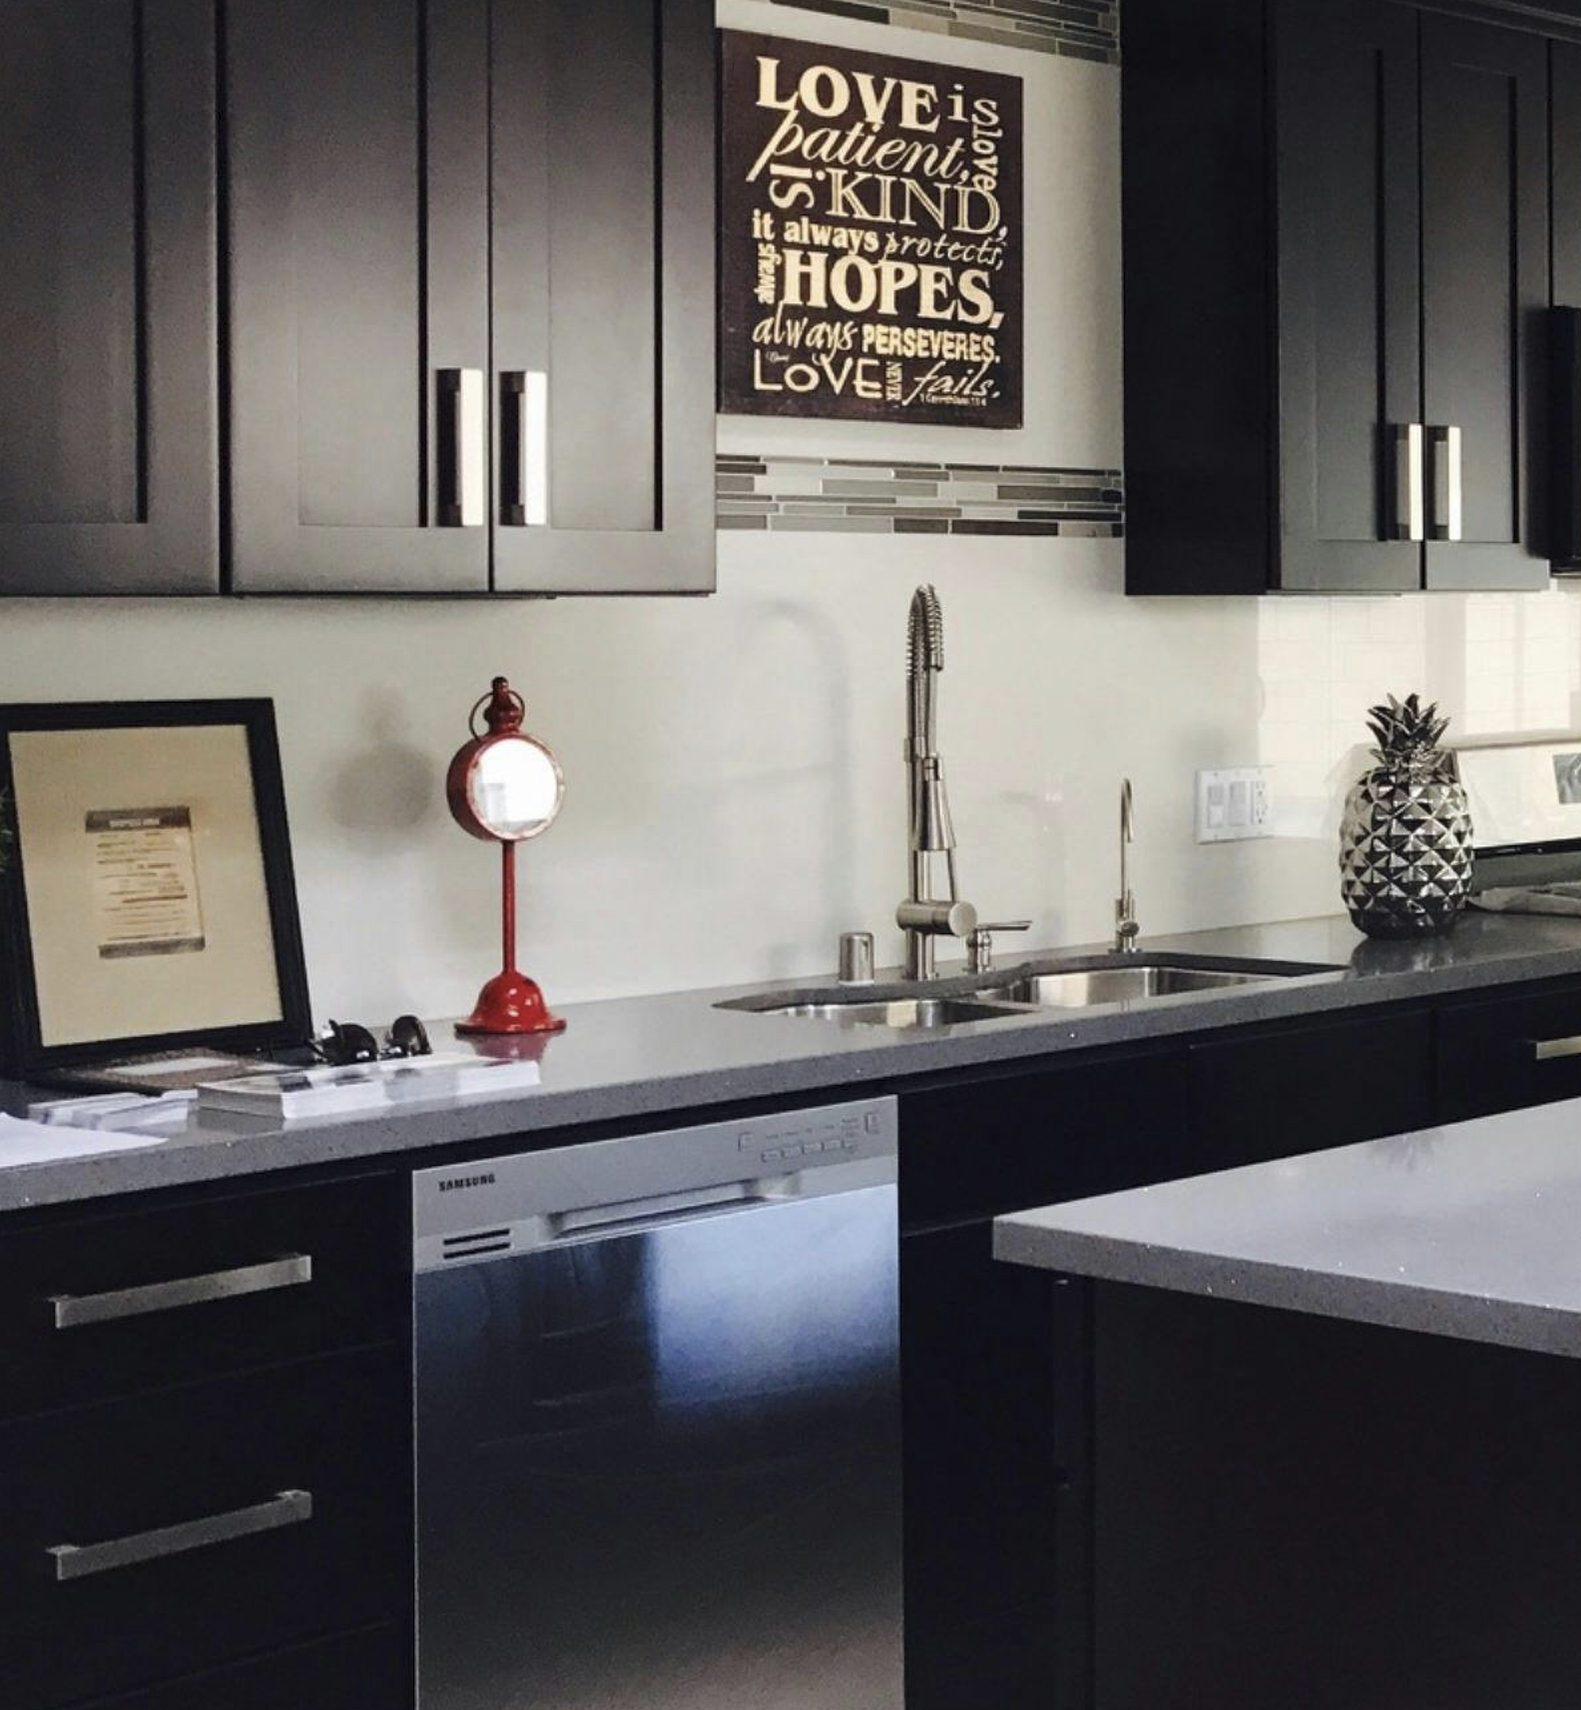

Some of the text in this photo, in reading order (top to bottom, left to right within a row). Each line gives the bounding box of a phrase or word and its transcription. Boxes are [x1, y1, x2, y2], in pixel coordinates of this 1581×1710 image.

[755, 56, 1000, 133] LOVE is
[971, 122, 1004, 194] love
[752, 208, 775, 241] it
[783, 215, 880, 256] always
[754, 242, 783, 305] always
[752, 301, 859, 366] always
[438, 1172, 496, 1192] SAMSUNG
